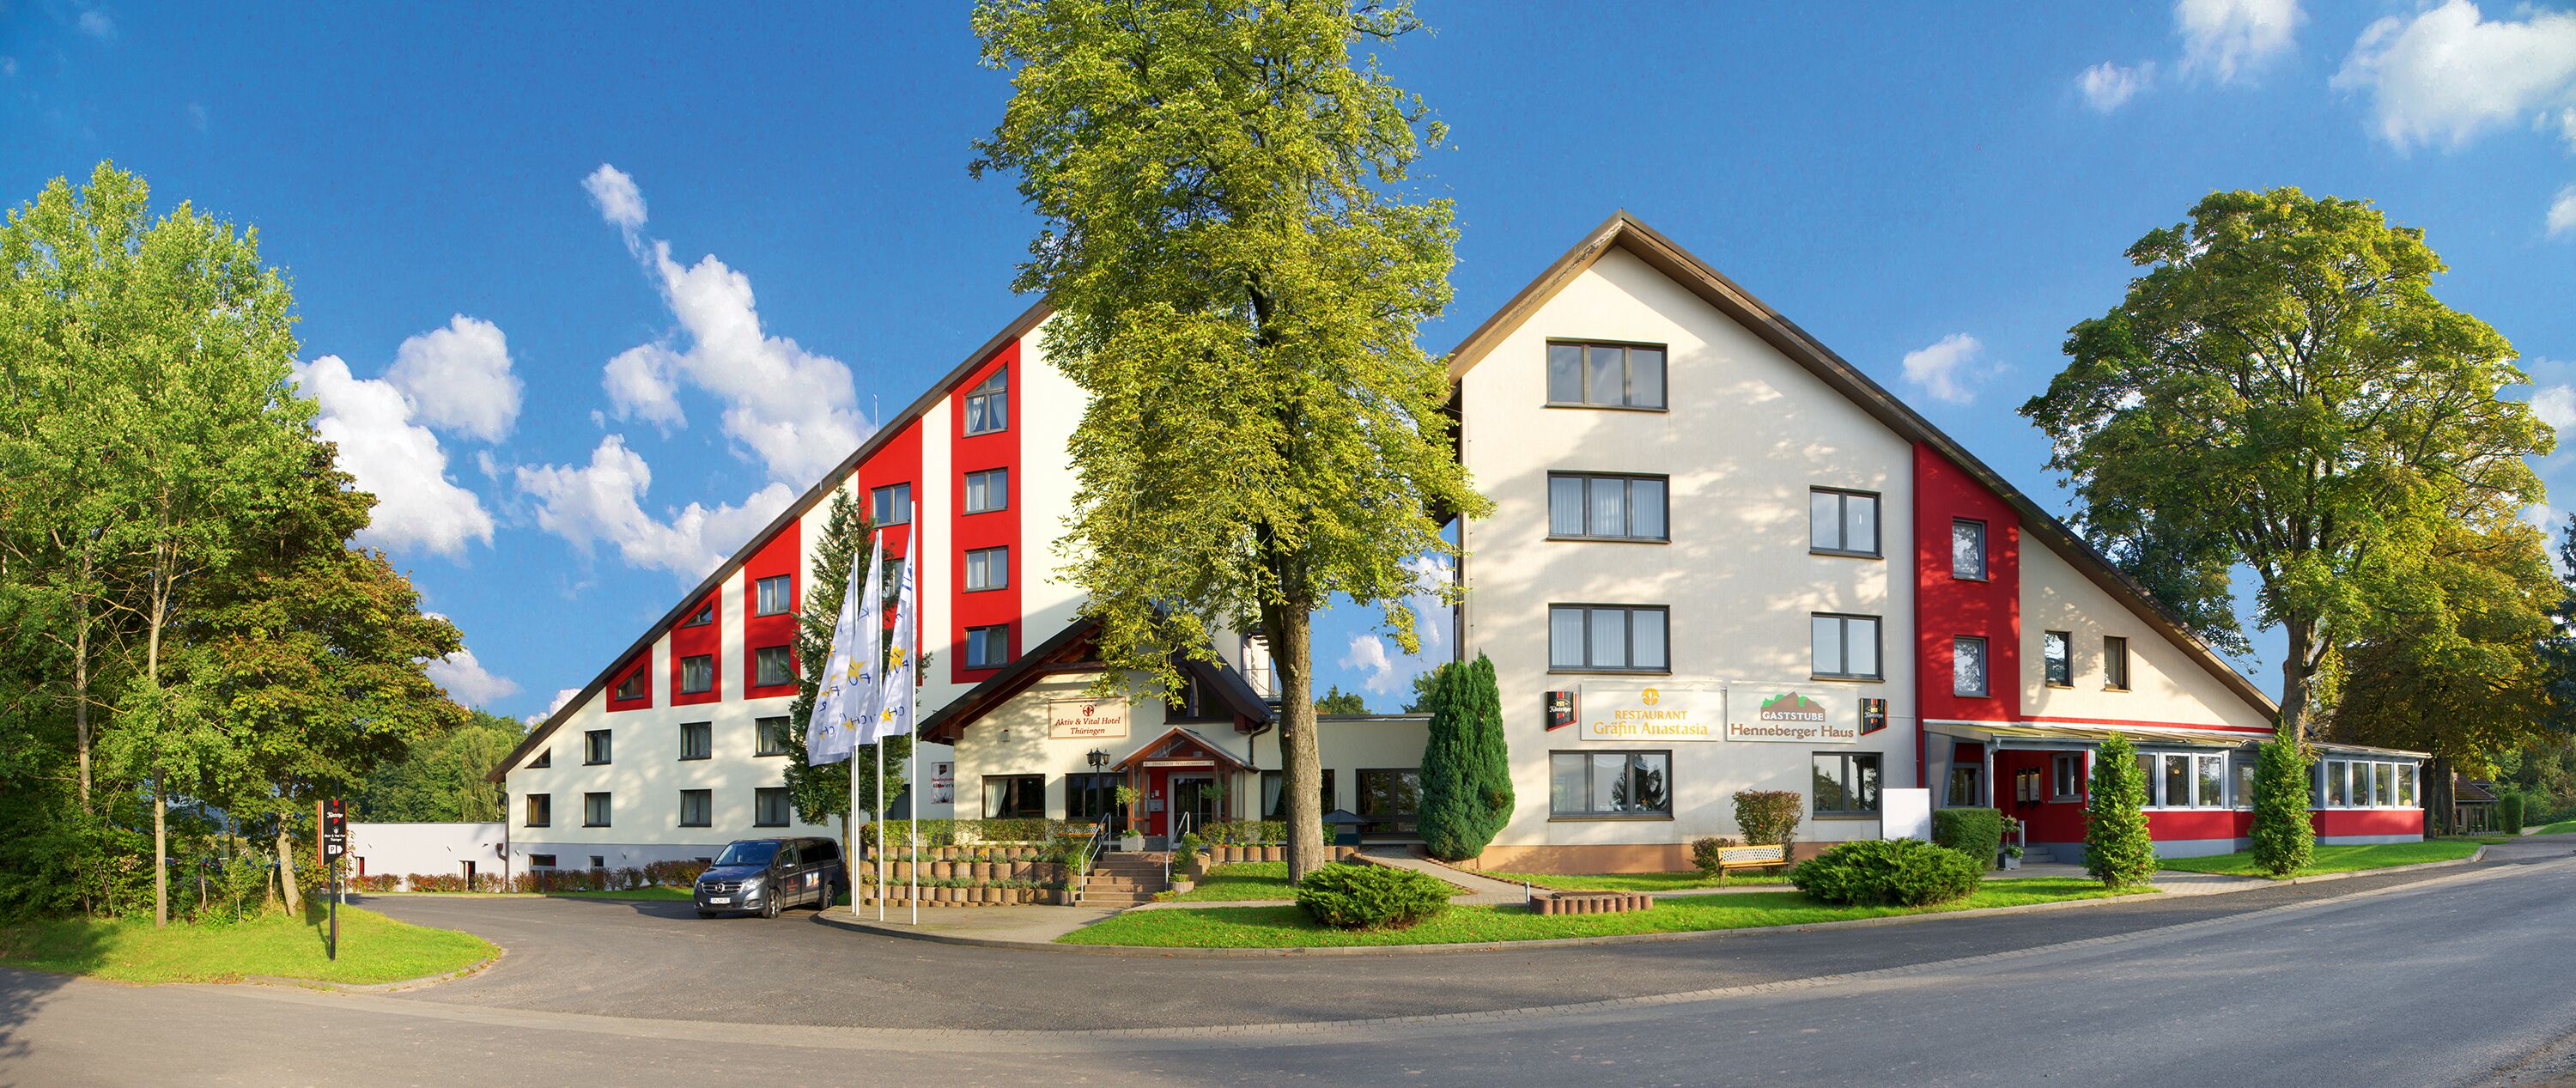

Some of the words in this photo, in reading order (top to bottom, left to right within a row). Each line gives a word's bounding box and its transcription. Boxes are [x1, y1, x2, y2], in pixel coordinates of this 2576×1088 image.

[1615, 710, 1687, 720] RESTAURANT
[1762, 711, 1824, 720] GASTSTUBE
[1071, 727, 1105, 736] Thüringen
[1594, 721, 1637, 737] Gräfin
[1641, 722, 1708, 735] Anastasia
[1730, 724, 1817, 739] Henneberger
[1821, 726, 1854, 738] Haus
